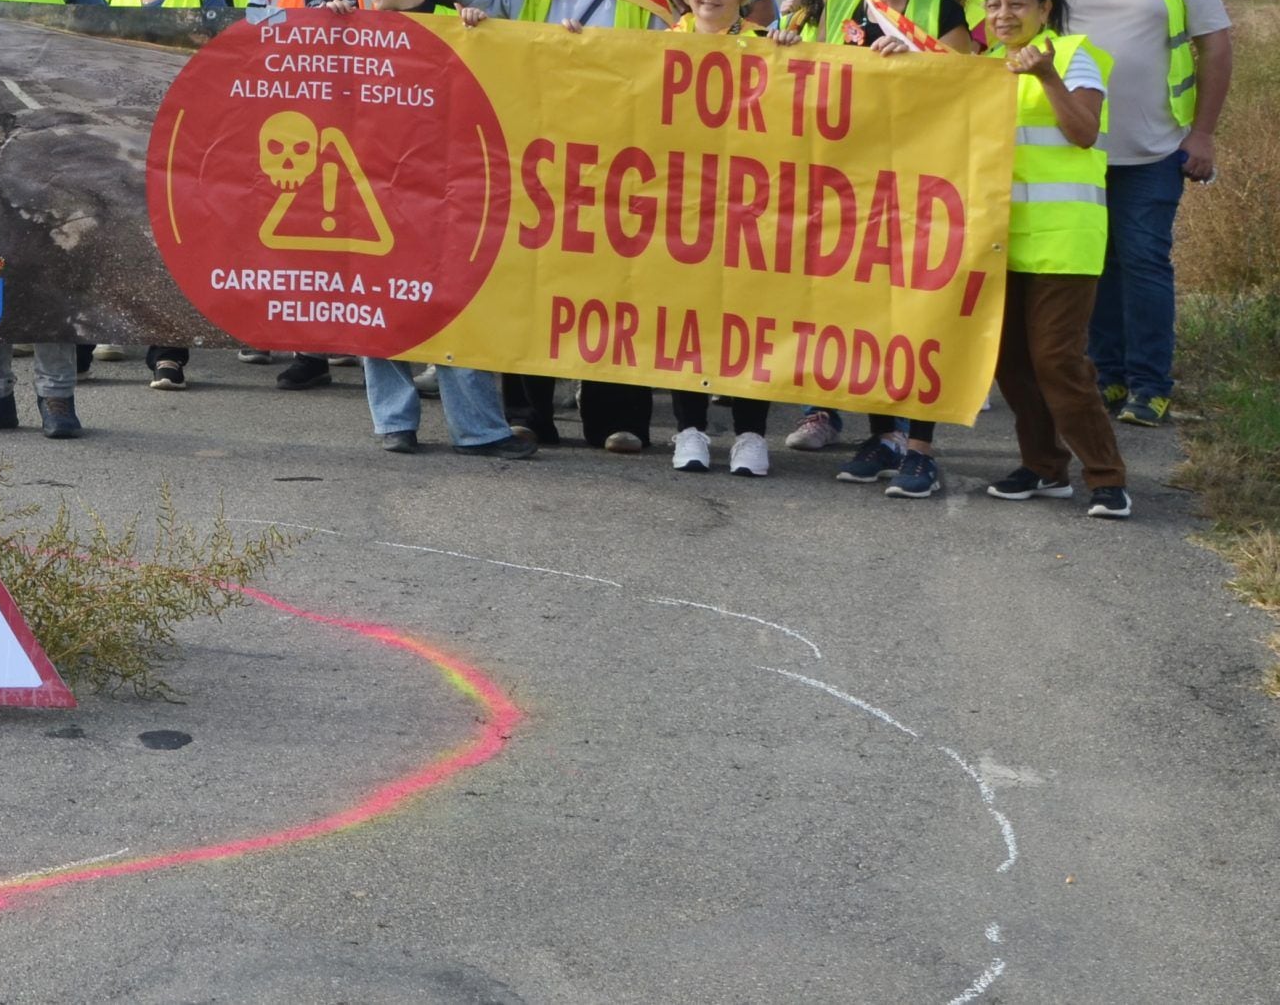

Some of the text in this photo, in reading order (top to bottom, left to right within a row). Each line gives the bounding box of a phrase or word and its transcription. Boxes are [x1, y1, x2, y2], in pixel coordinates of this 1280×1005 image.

[260, 25, 412, 50] PLATAFORMA
[264, 54, 396, 78] CARRETERA
[229, 79, 333, 100] ALBALATE
[360, 84, 435, 107] ESPLÚS
[660, 48, 854, 141] POR TU
[518, 137, 987, 317] SEGURIDAD,
[210, 268, 345, 293] CARRETERA
[350, 273, 366, 295] A
[387, 277, 434, 303] 1239
[267, 300, 387, 329] PELIGROSA
[549, 295, 942, 405] POR LA DE TODOS
